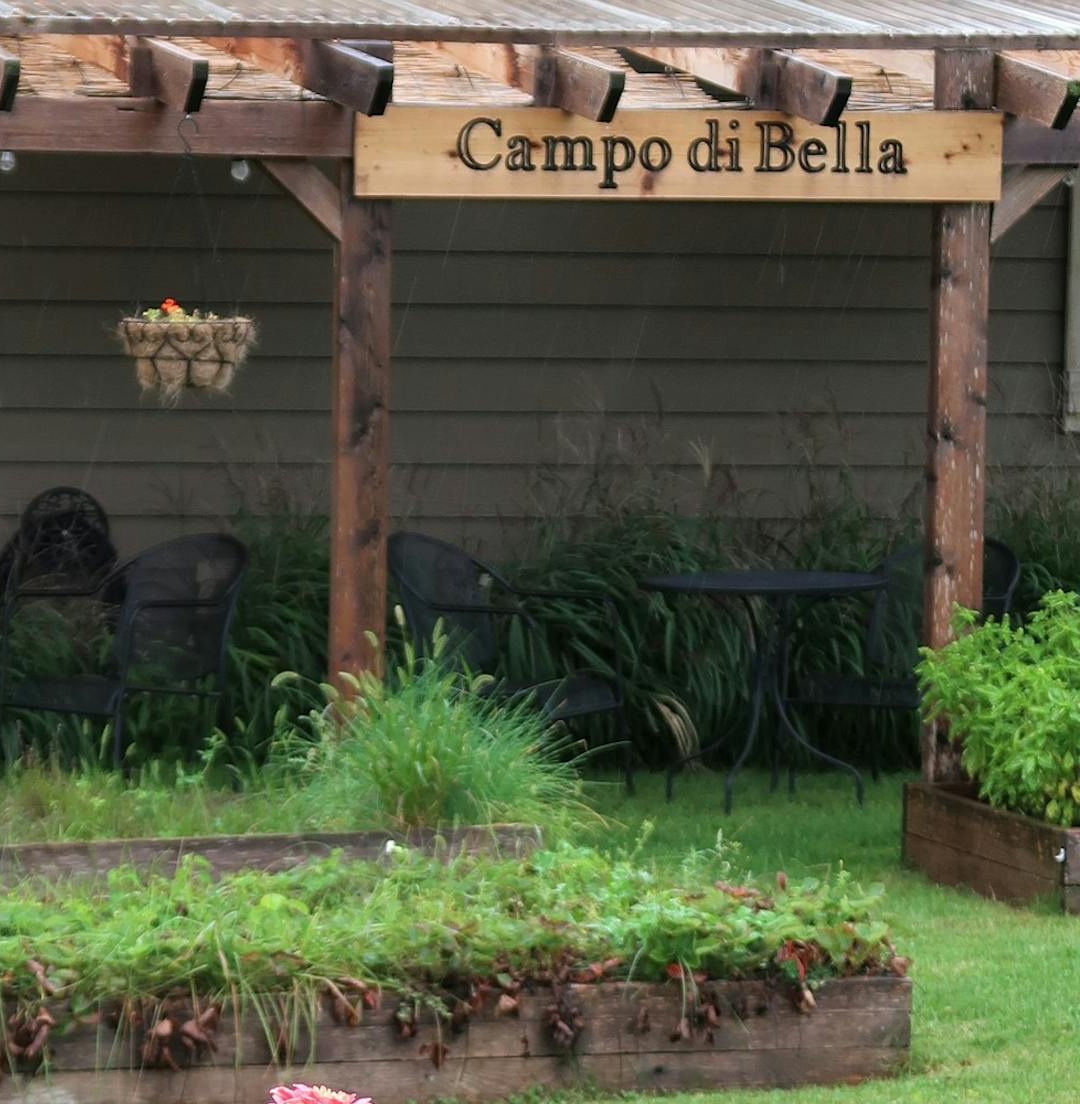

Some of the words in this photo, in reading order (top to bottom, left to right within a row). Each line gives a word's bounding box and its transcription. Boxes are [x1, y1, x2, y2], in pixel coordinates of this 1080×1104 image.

[457, 117, 672, 189] Campo
[687, 119, 742, 172] di
[754, 120, 907, 174] Bella
